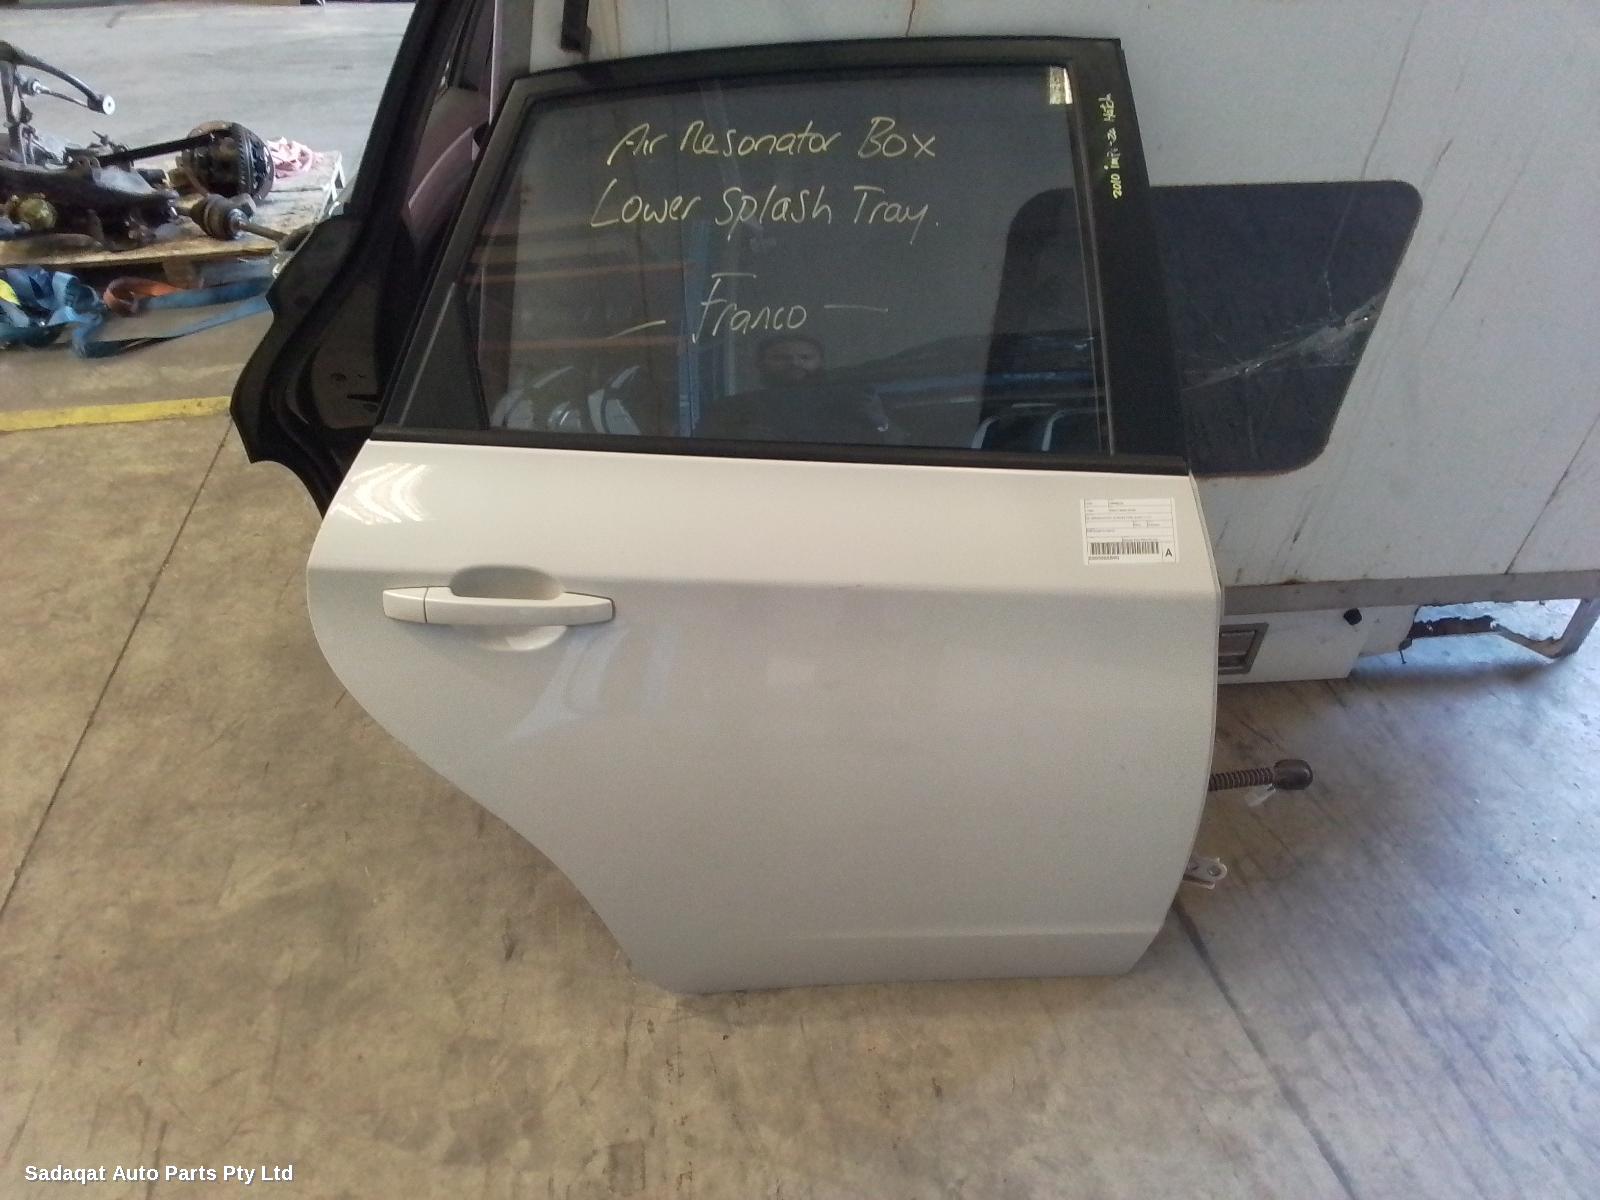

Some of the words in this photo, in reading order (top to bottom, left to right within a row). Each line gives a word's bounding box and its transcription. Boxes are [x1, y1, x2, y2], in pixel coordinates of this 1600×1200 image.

[606, 122, 668, 166] Air
[680, 119, 841, 158] Resonator
[857, 116, 936, 159] Box
[590, 178, 702, 228] Lower
[715, 184, 832, 242] Splash
[1165, 548, 1173, 557] A
